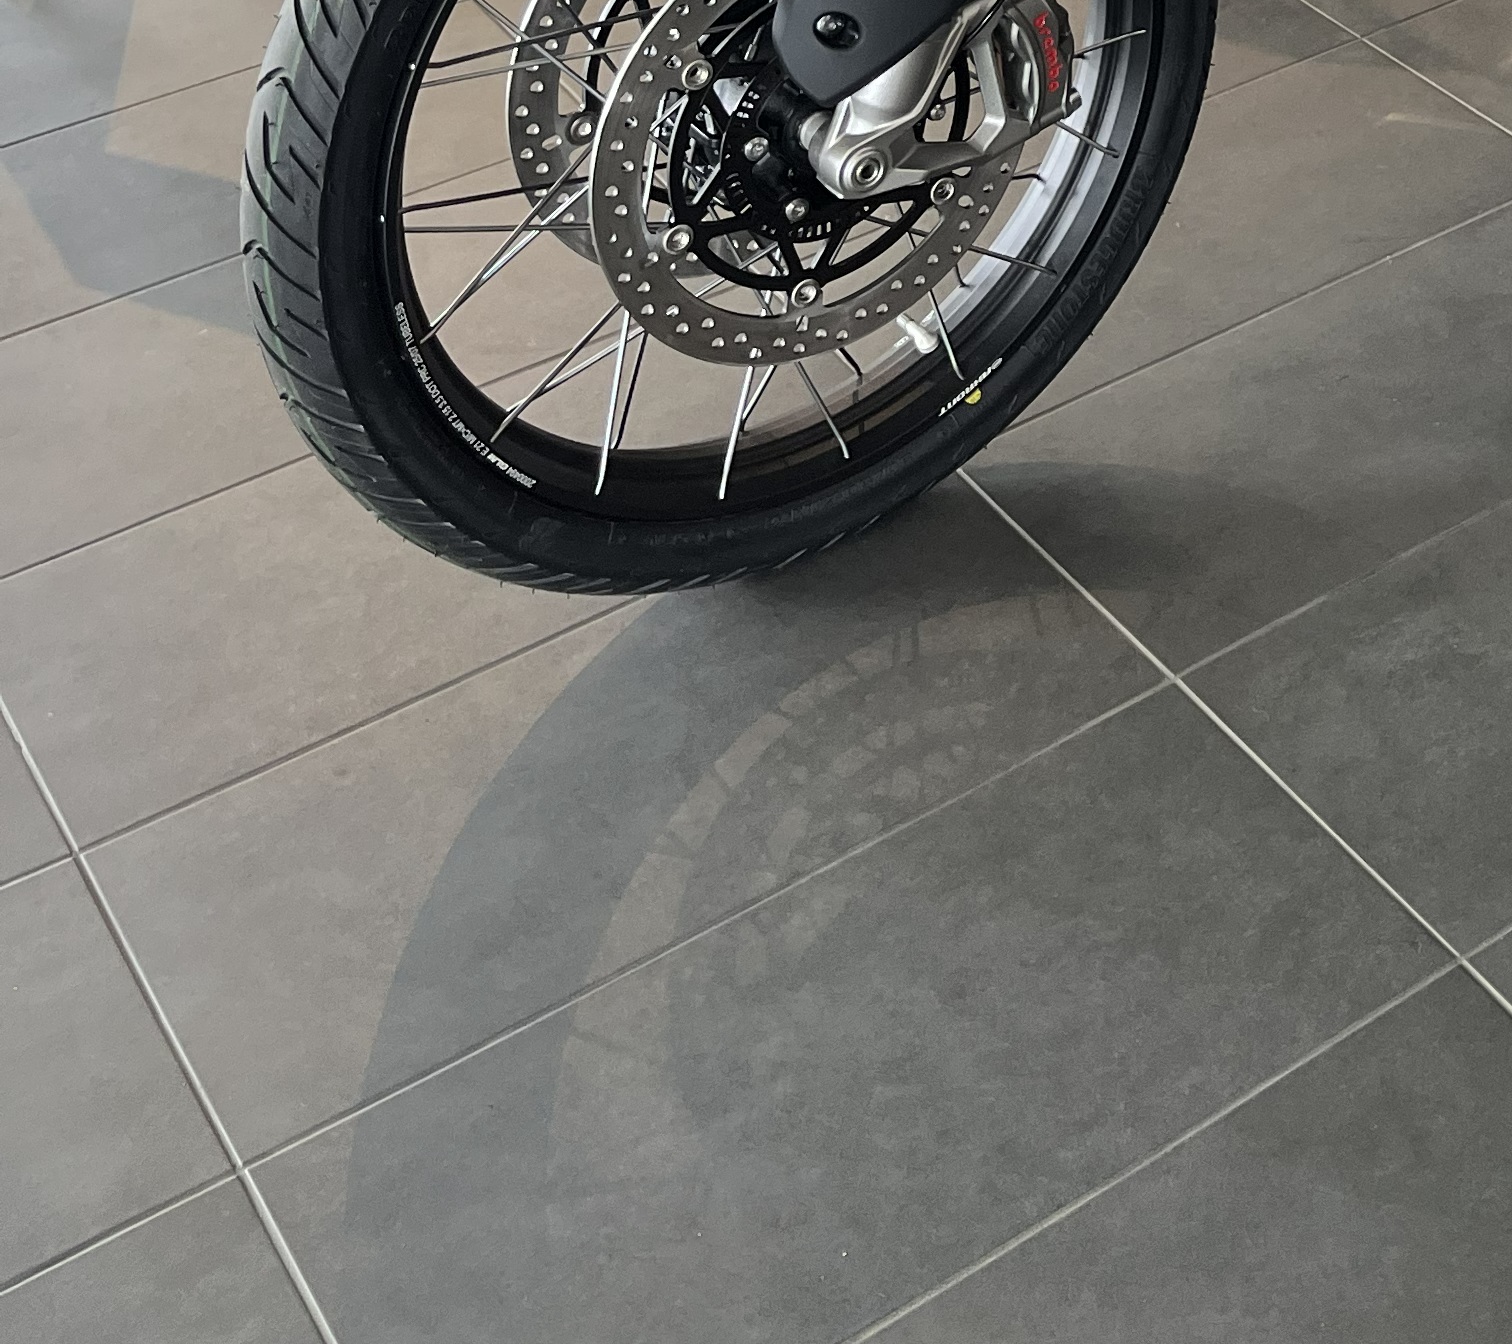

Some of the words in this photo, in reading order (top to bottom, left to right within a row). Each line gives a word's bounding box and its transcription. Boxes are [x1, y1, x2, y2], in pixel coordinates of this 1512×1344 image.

[1033, 10, 1063, 93] brembo
[394, 302, 414, 346] TUBELESS
[425, 380, 441, 398] DOT
